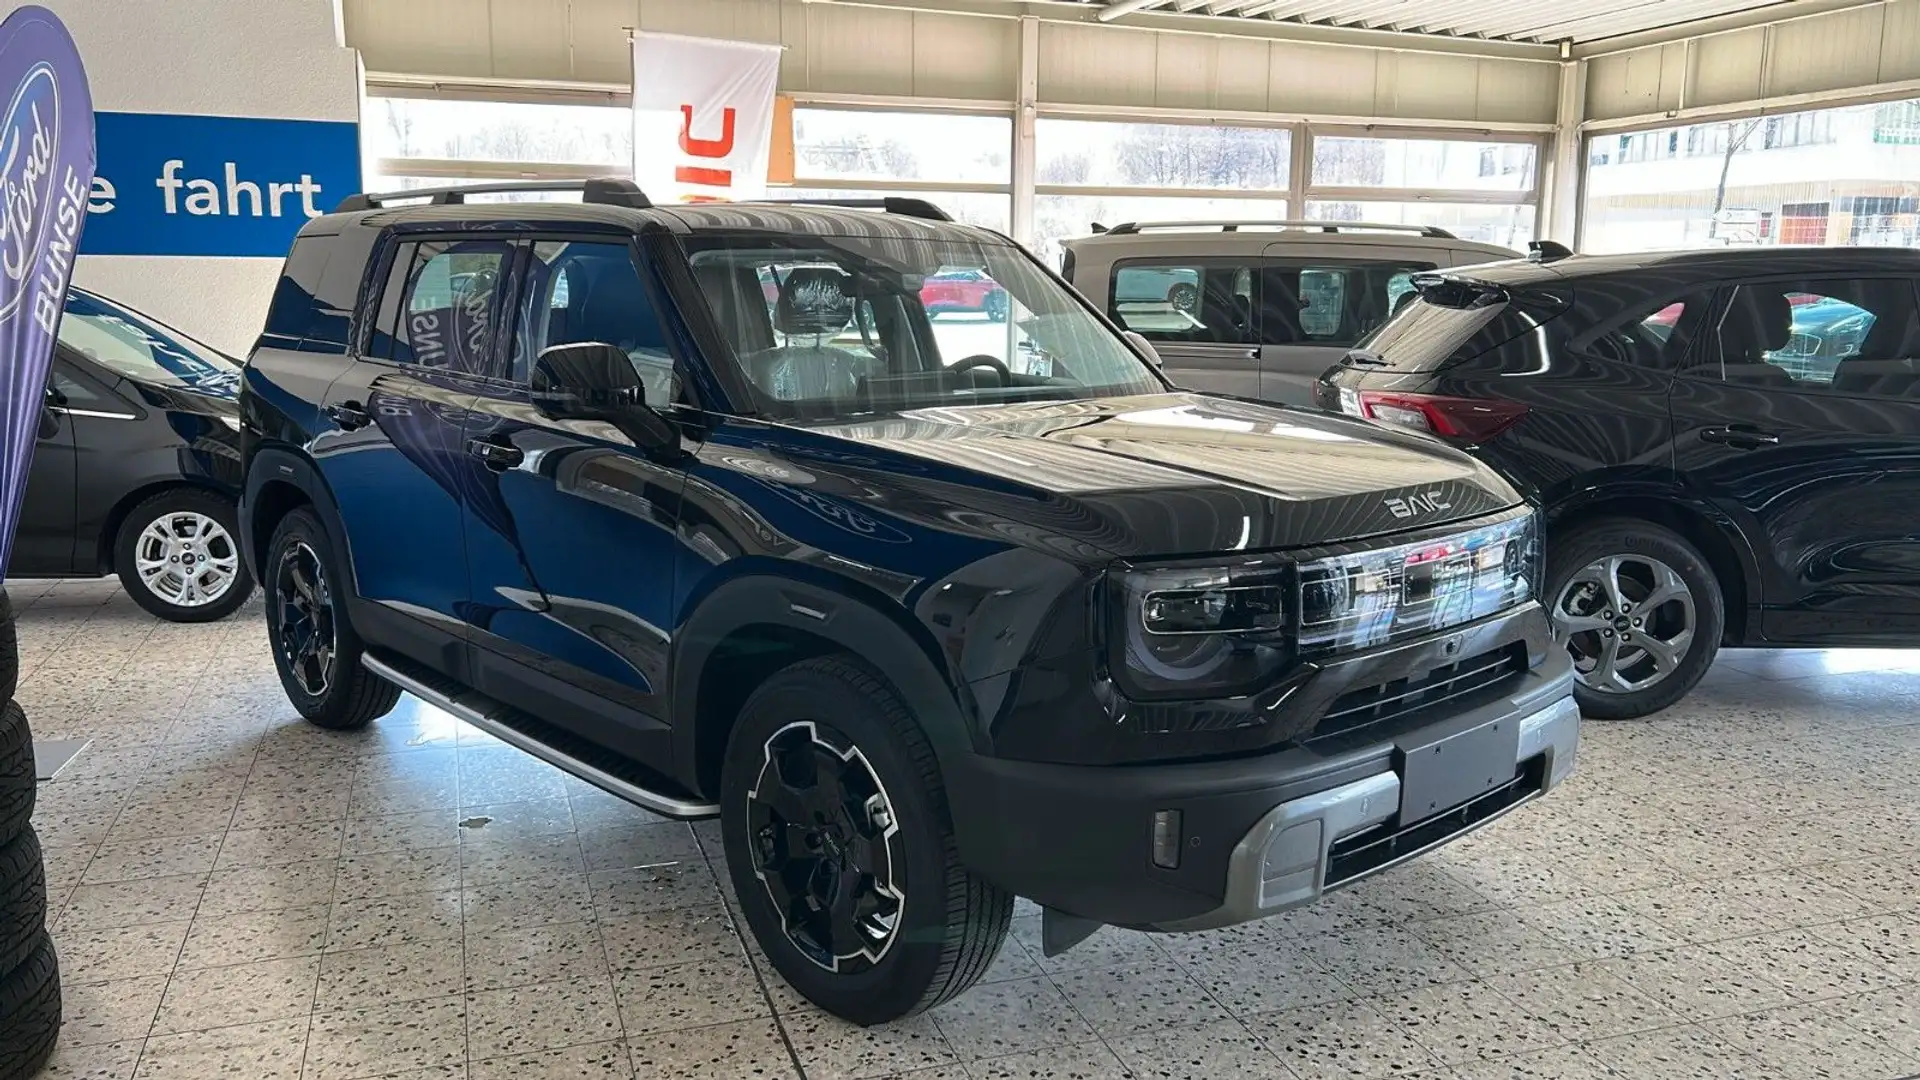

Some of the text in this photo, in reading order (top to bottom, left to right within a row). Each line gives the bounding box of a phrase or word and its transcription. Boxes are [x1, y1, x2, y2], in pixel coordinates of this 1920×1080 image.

[0, 100, 51, 281] Ford
[156, 160, 323, 217] fahrt
[34, 165, 86, 336] BUNSE
[1383, 491, 1452, 518] BAIC
